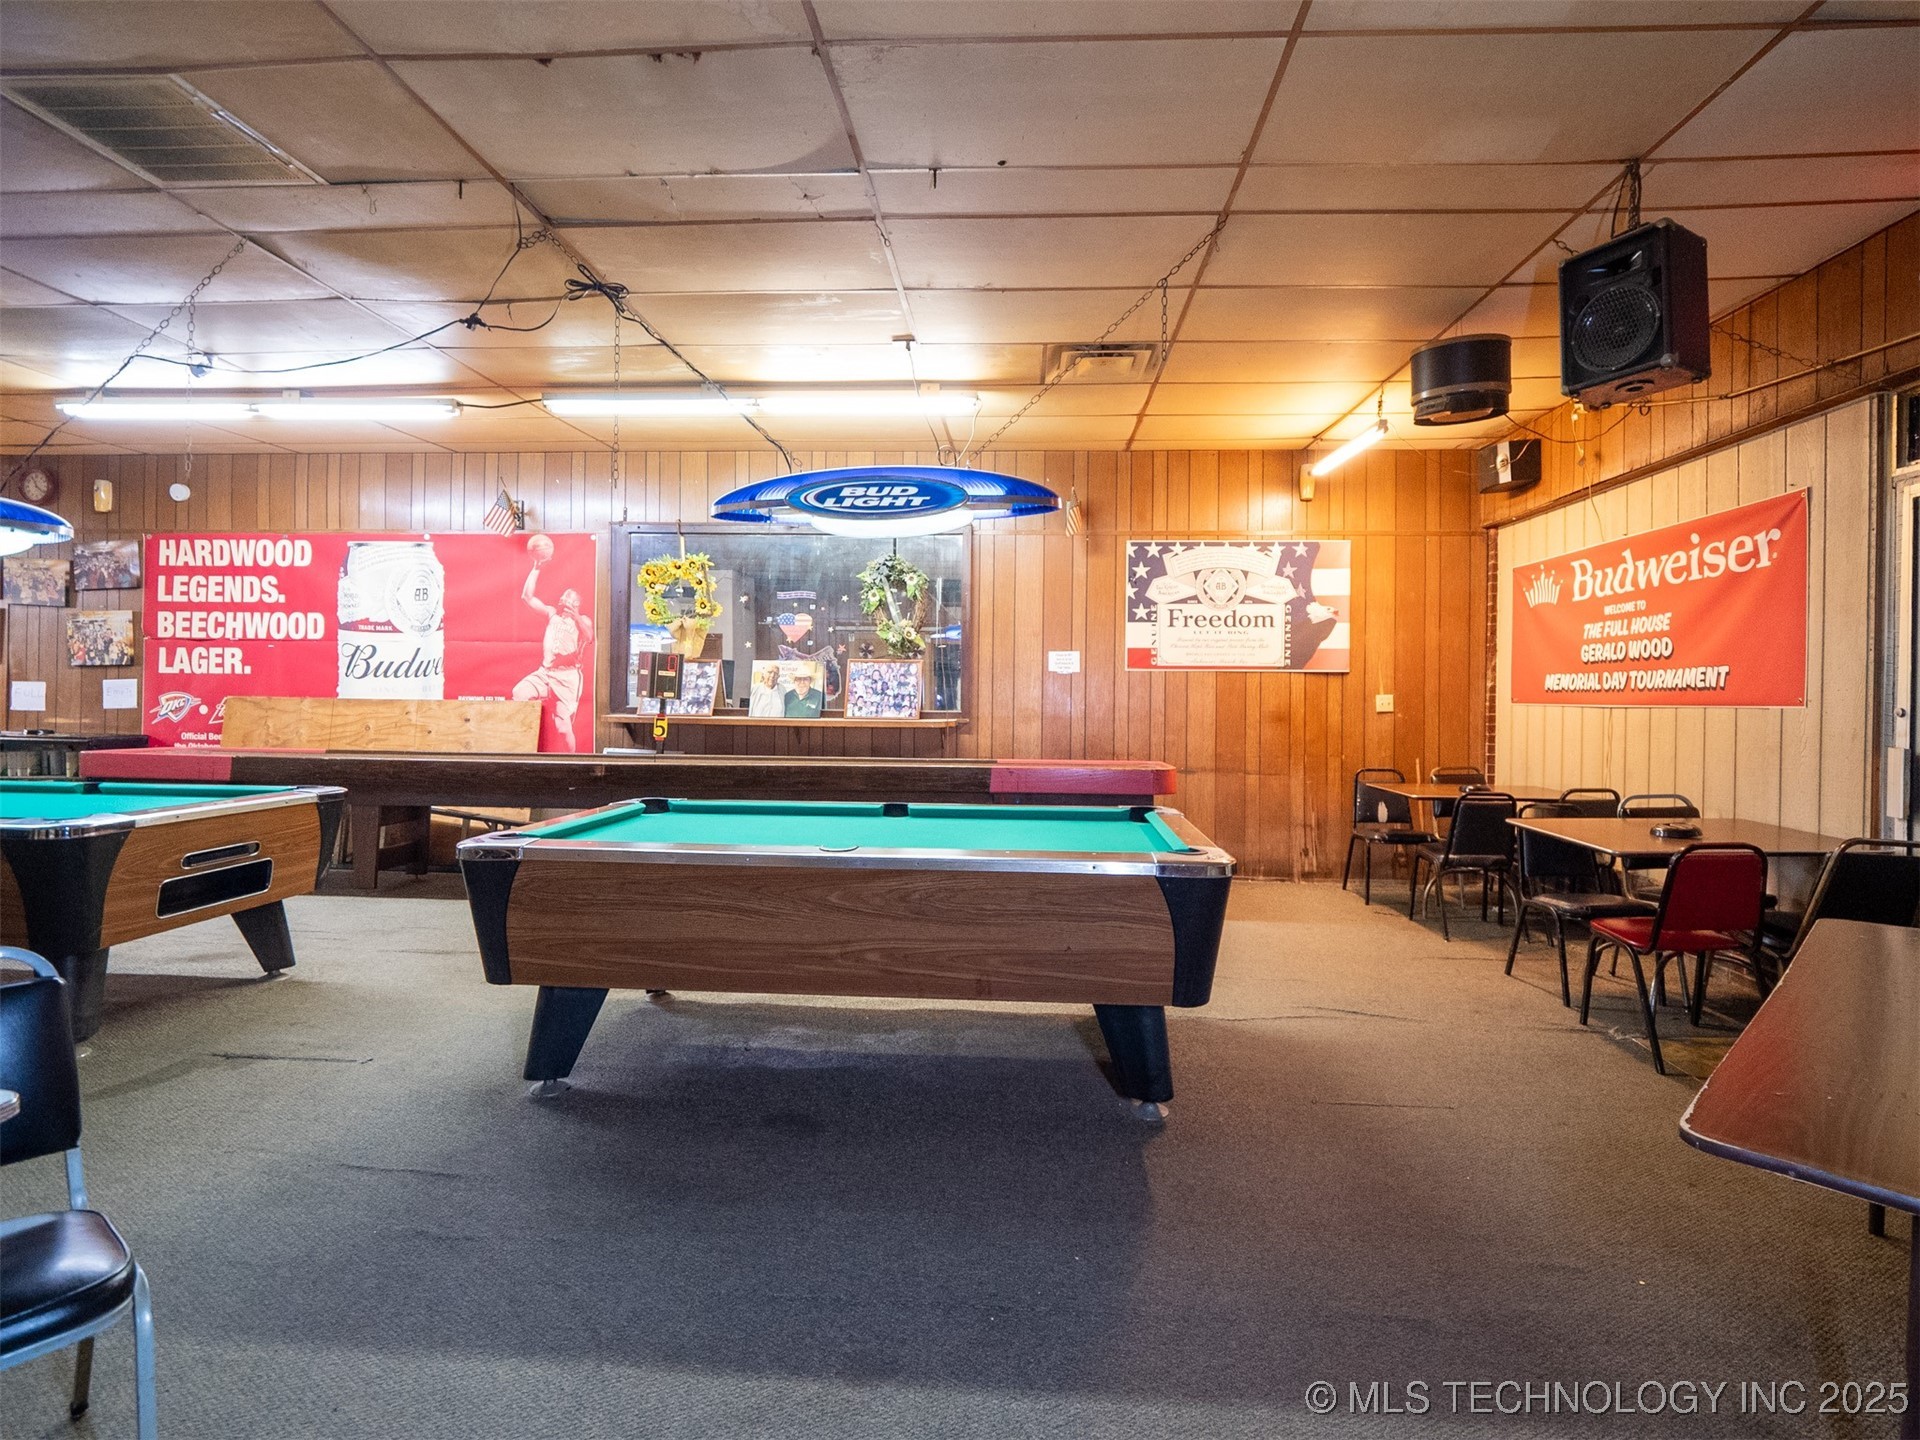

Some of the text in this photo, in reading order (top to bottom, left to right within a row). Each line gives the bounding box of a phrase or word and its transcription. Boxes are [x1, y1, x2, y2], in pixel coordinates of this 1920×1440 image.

[822, 496, 931, 508] LIGHT
[839, 486, 919, 497] BUD
[158, 539, 313, 567] HARDWOOD
[1570, 528, 1782, 602] Budweiser
[157, 575, 286, 603] LEGENDS.
[1167, 608, 1275, 628] Freedom
[1604, 600, 1646, 615] WELCOME TO
[157, 611, 325, 640] BEECHWOOD
[1583, 612, 1673, 640] THE FULL HOUSE
[158, 647, 252, 675] LAGER.
[1581, 637, 1674, 663] GERALD WOOD
[1544, 665, 1730, 692] MEMORIAL DAY TOURNAMENT
[181, 732, 207, 740] Official
[654, 718, 665, 736] 5
